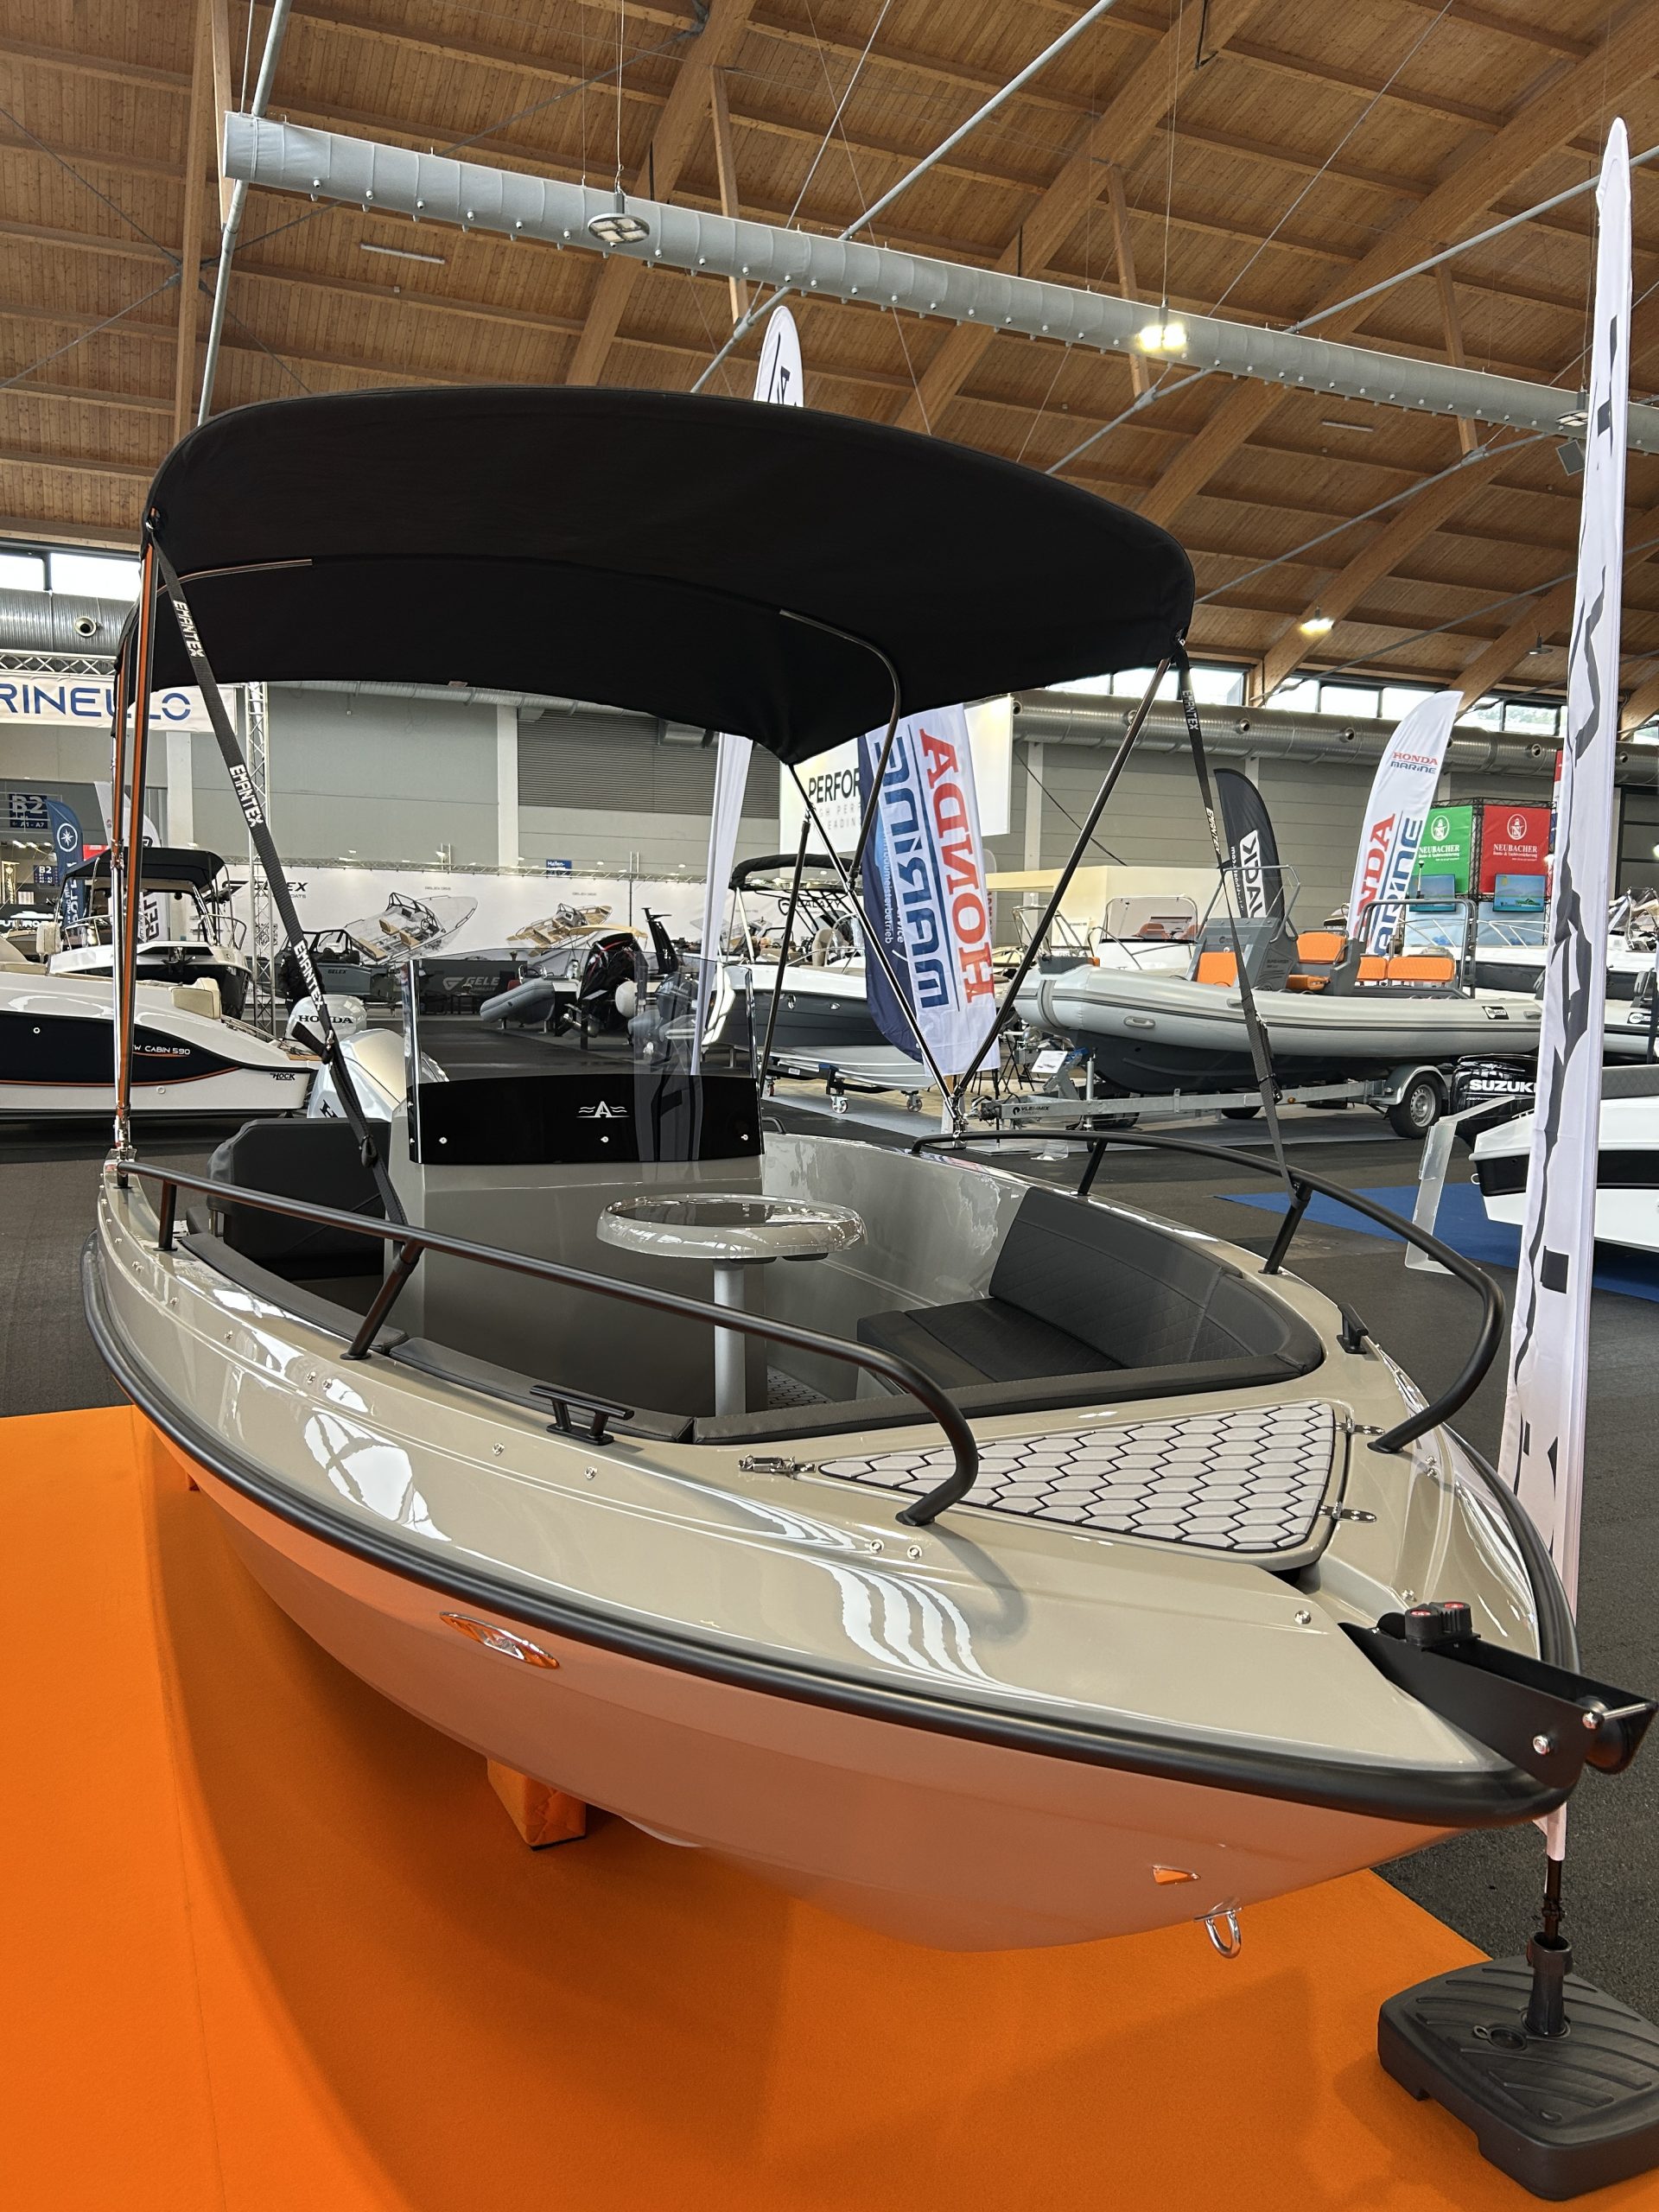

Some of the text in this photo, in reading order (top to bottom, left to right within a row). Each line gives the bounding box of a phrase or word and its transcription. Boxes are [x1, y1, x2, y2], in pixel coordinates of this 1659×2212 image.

[173, 600, 205, 658] EMANTEX
[0, 683, 191, 721] RINELO
[1392, 752, 1439, 766] HONDA
[809, 766, 860, 804] PERFOR
[12, 795, 43, 814] B2
[228, 765, 264, 828] EMANTEX
[1205, 807, 1221, 855] EMANTEX
[1418, 844, 1460, 855] NEUBACHER
[1493, 843, 1538, 854] NEUBACHER
[39, 866, 52, 874] B2
[294, 939, 323, 1011] EMANTEX
[467, 976, 500, 986] GELE
[298, 1014, 353, 1024] HODA
[144, 1045, 171, 1053] CABIN
